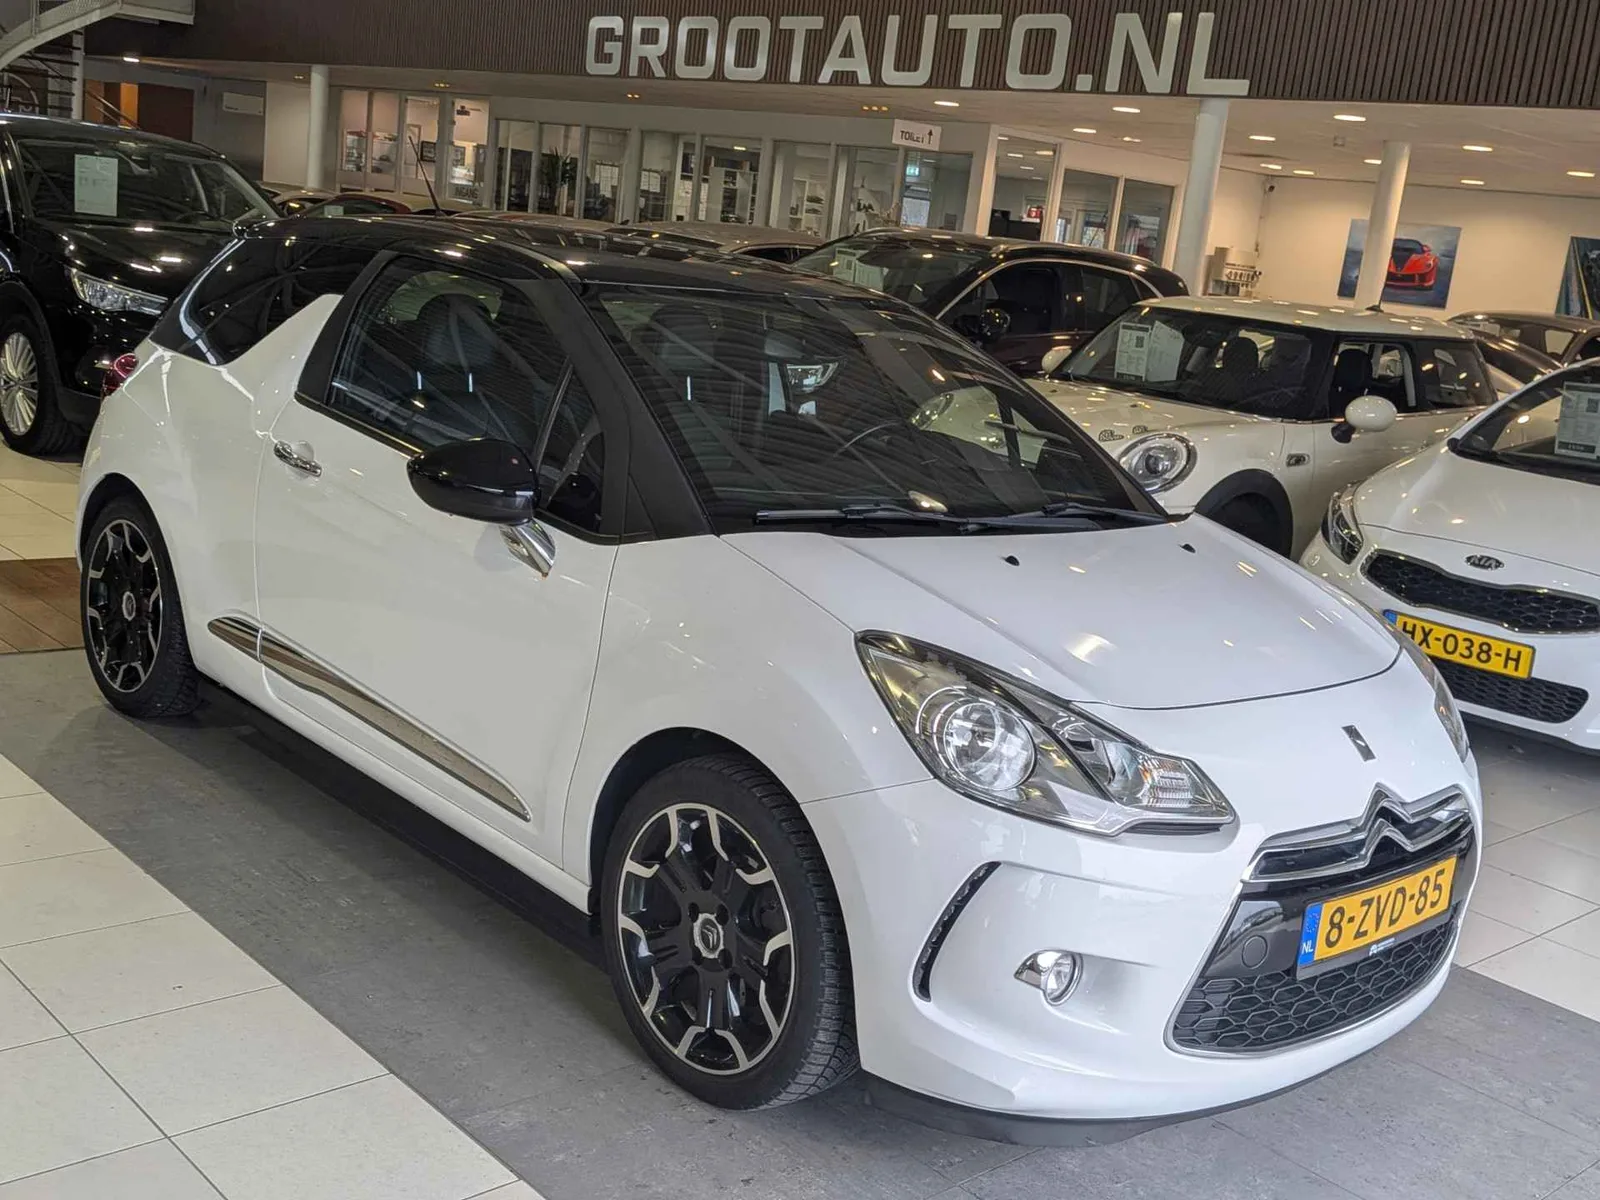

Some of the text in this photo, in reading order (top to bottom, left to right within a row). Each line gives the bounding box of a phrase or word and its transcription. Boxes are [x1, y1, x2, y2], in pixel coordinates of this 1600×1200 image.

[585, 11, 1250, 95] GROOTAUTO.NL
[1402, 621, 1522, 672] HX-038-H
[1325, 868, 1445, 948] 8-ZVD-85
[1302, 942, 1314, 954] NL
